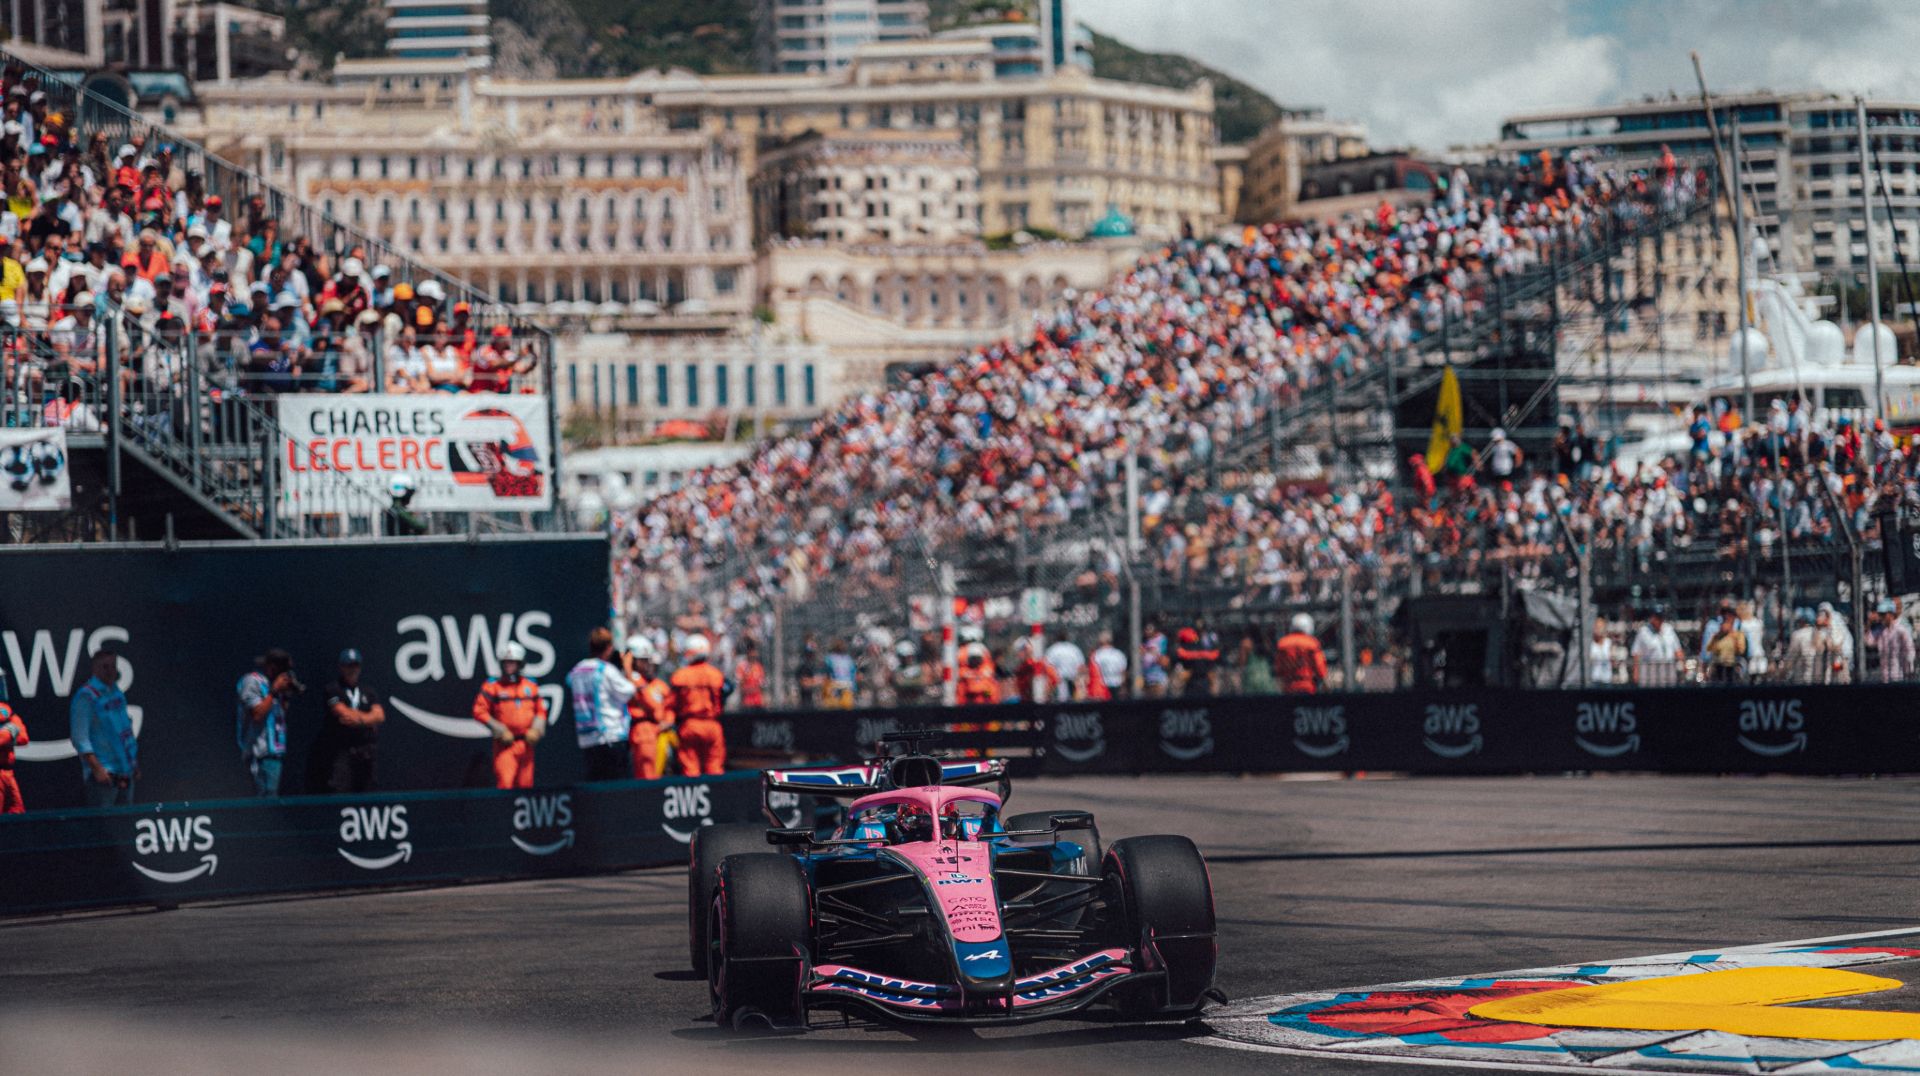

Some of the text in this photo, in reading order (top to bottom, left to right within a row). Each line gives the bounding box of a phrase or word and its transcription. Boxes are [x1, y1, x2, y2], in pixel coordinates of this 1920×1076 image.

[309, 408, 445, 435] CHARLES
[286, 438, 444, 472] LECLERC
[395, 610, 556, 683] aws
[1294, 705, 1347, 734] aws
[1424, 704, 1480, 733] aws
[1577, 702, 1637, 734] aws
[1739, 700, 1804, 731] aws
[512, 794, 572, 828] aws
[663, 784, 711, 819] aws
[134, 815, 214, 855] aws
[339, 804, 409, 843] aws
